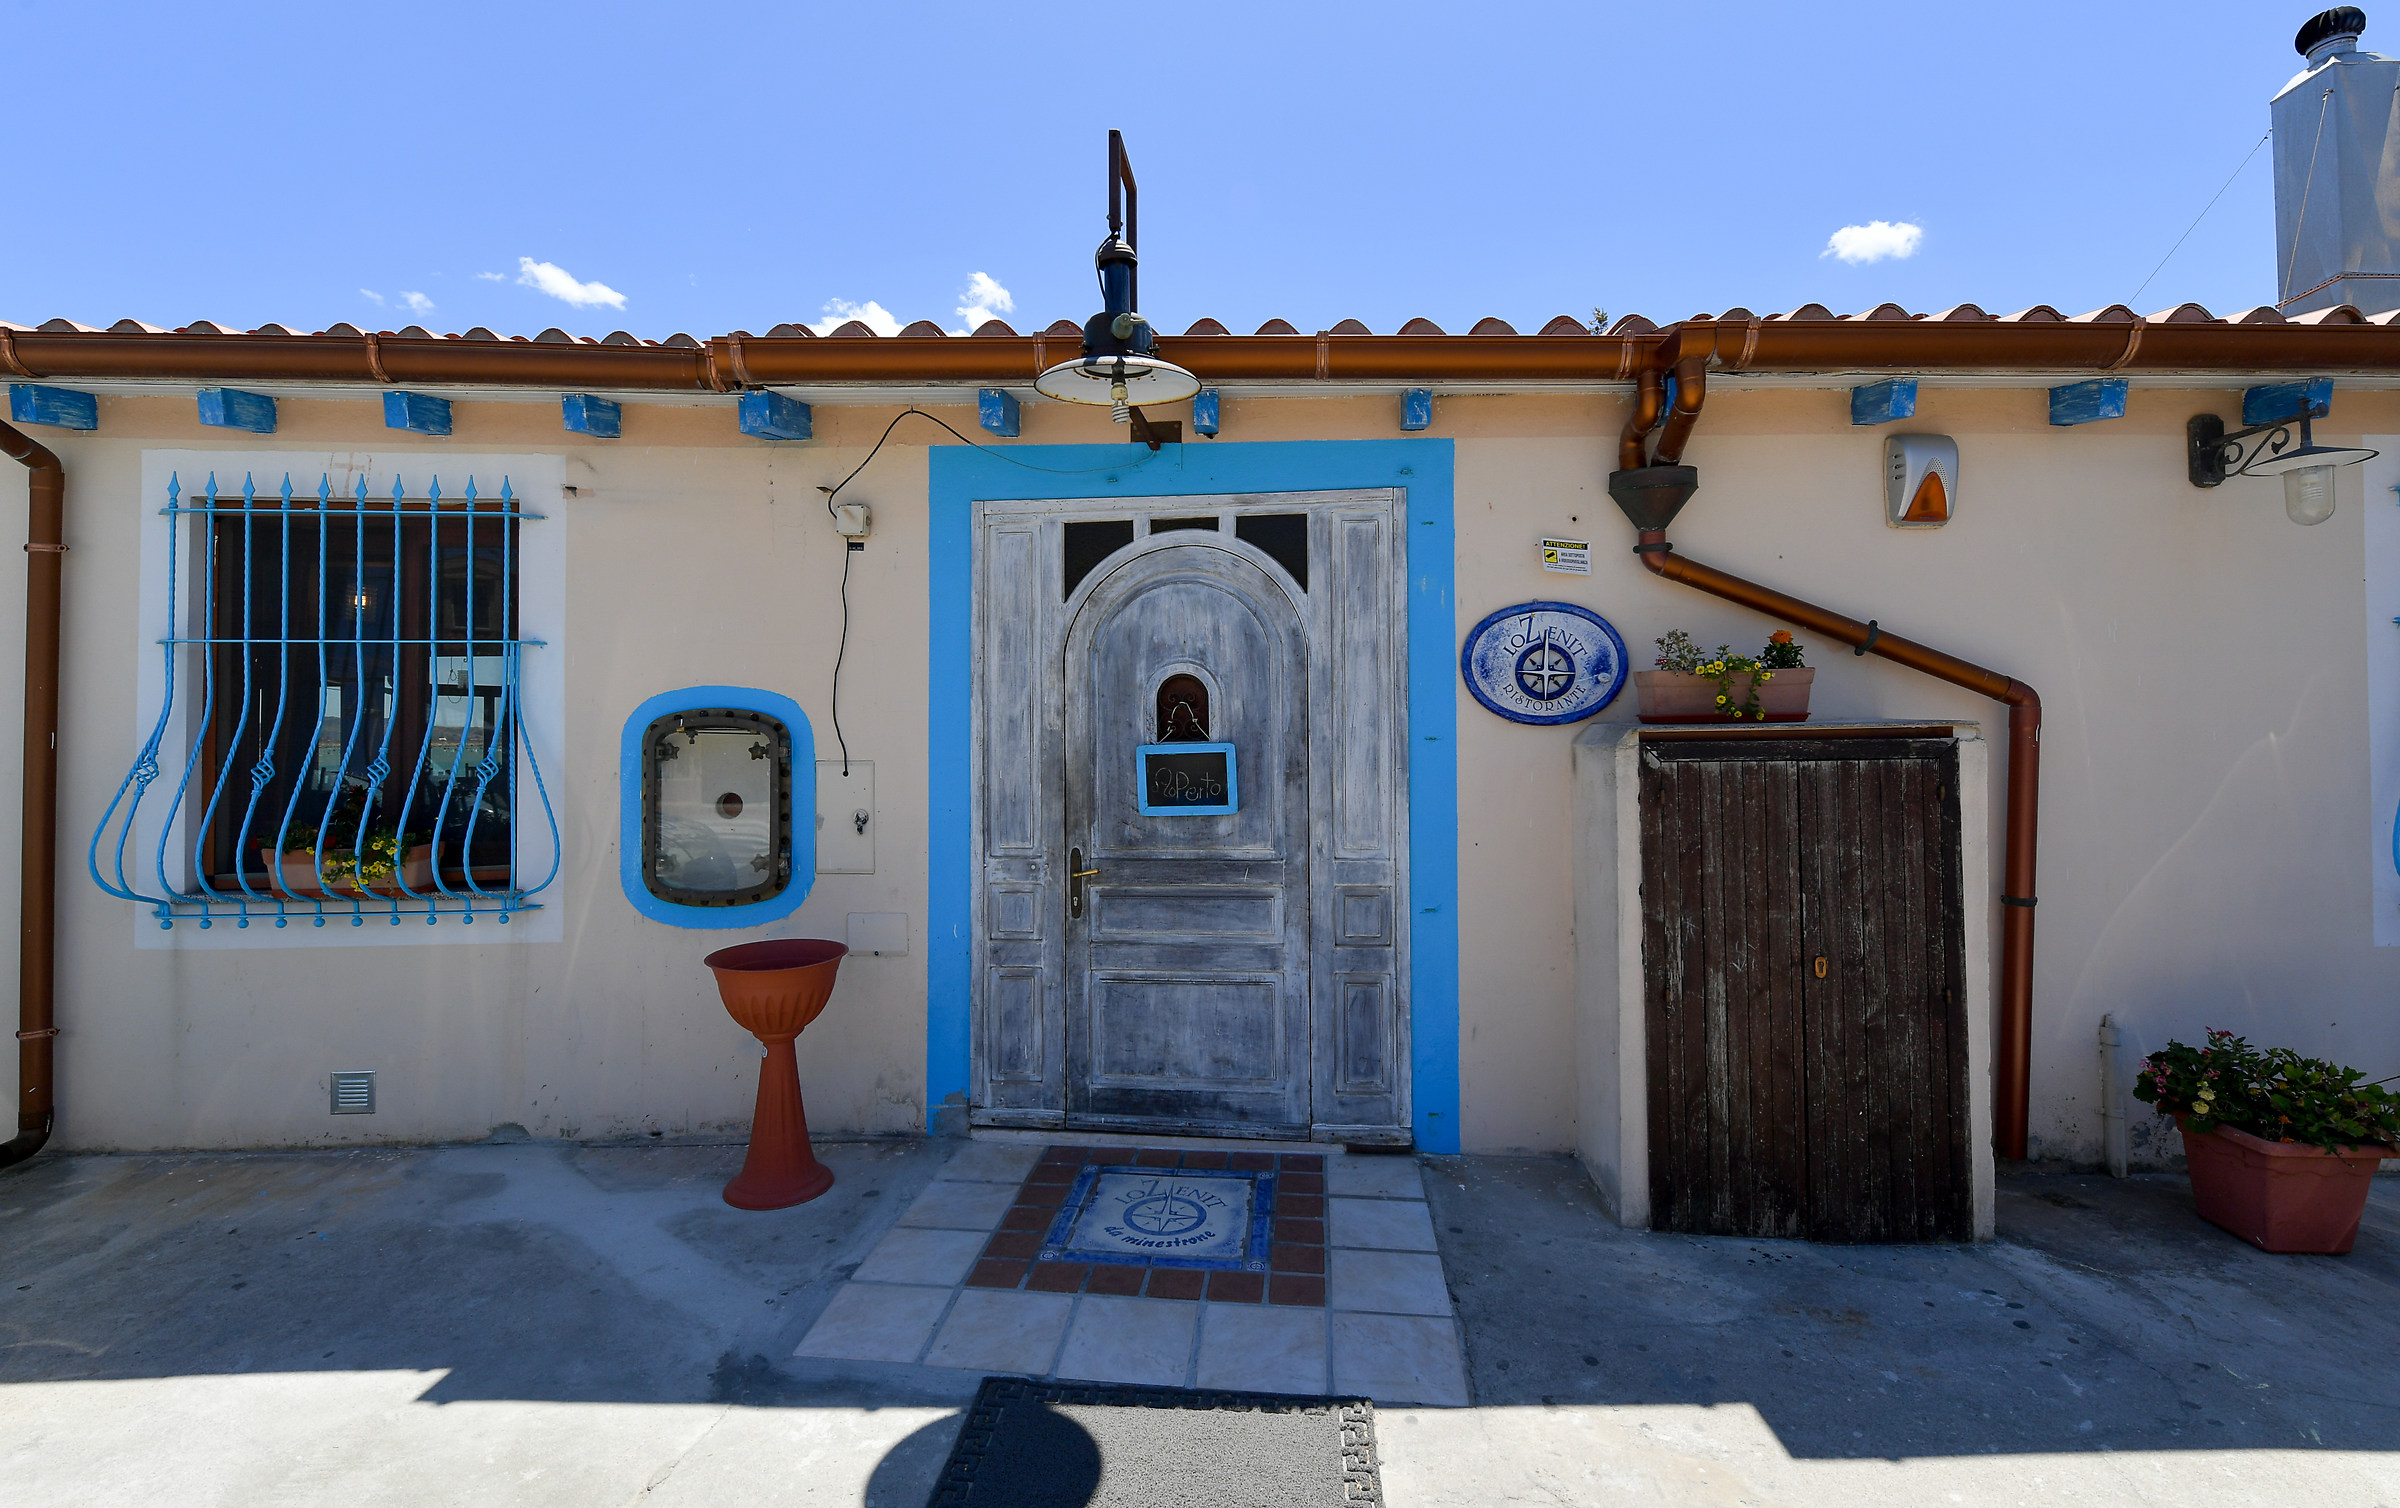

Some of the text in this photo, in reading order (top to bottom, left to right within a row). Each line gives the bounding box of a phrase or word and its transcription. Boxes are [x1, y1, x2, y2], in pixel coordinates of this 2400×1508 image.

[1545, 541, 1586, 549] ATTENZIONE!
[1503, 683, 1586, 711] RISTORANTE
[1121, 1230, 1216, 1248] minestrone
